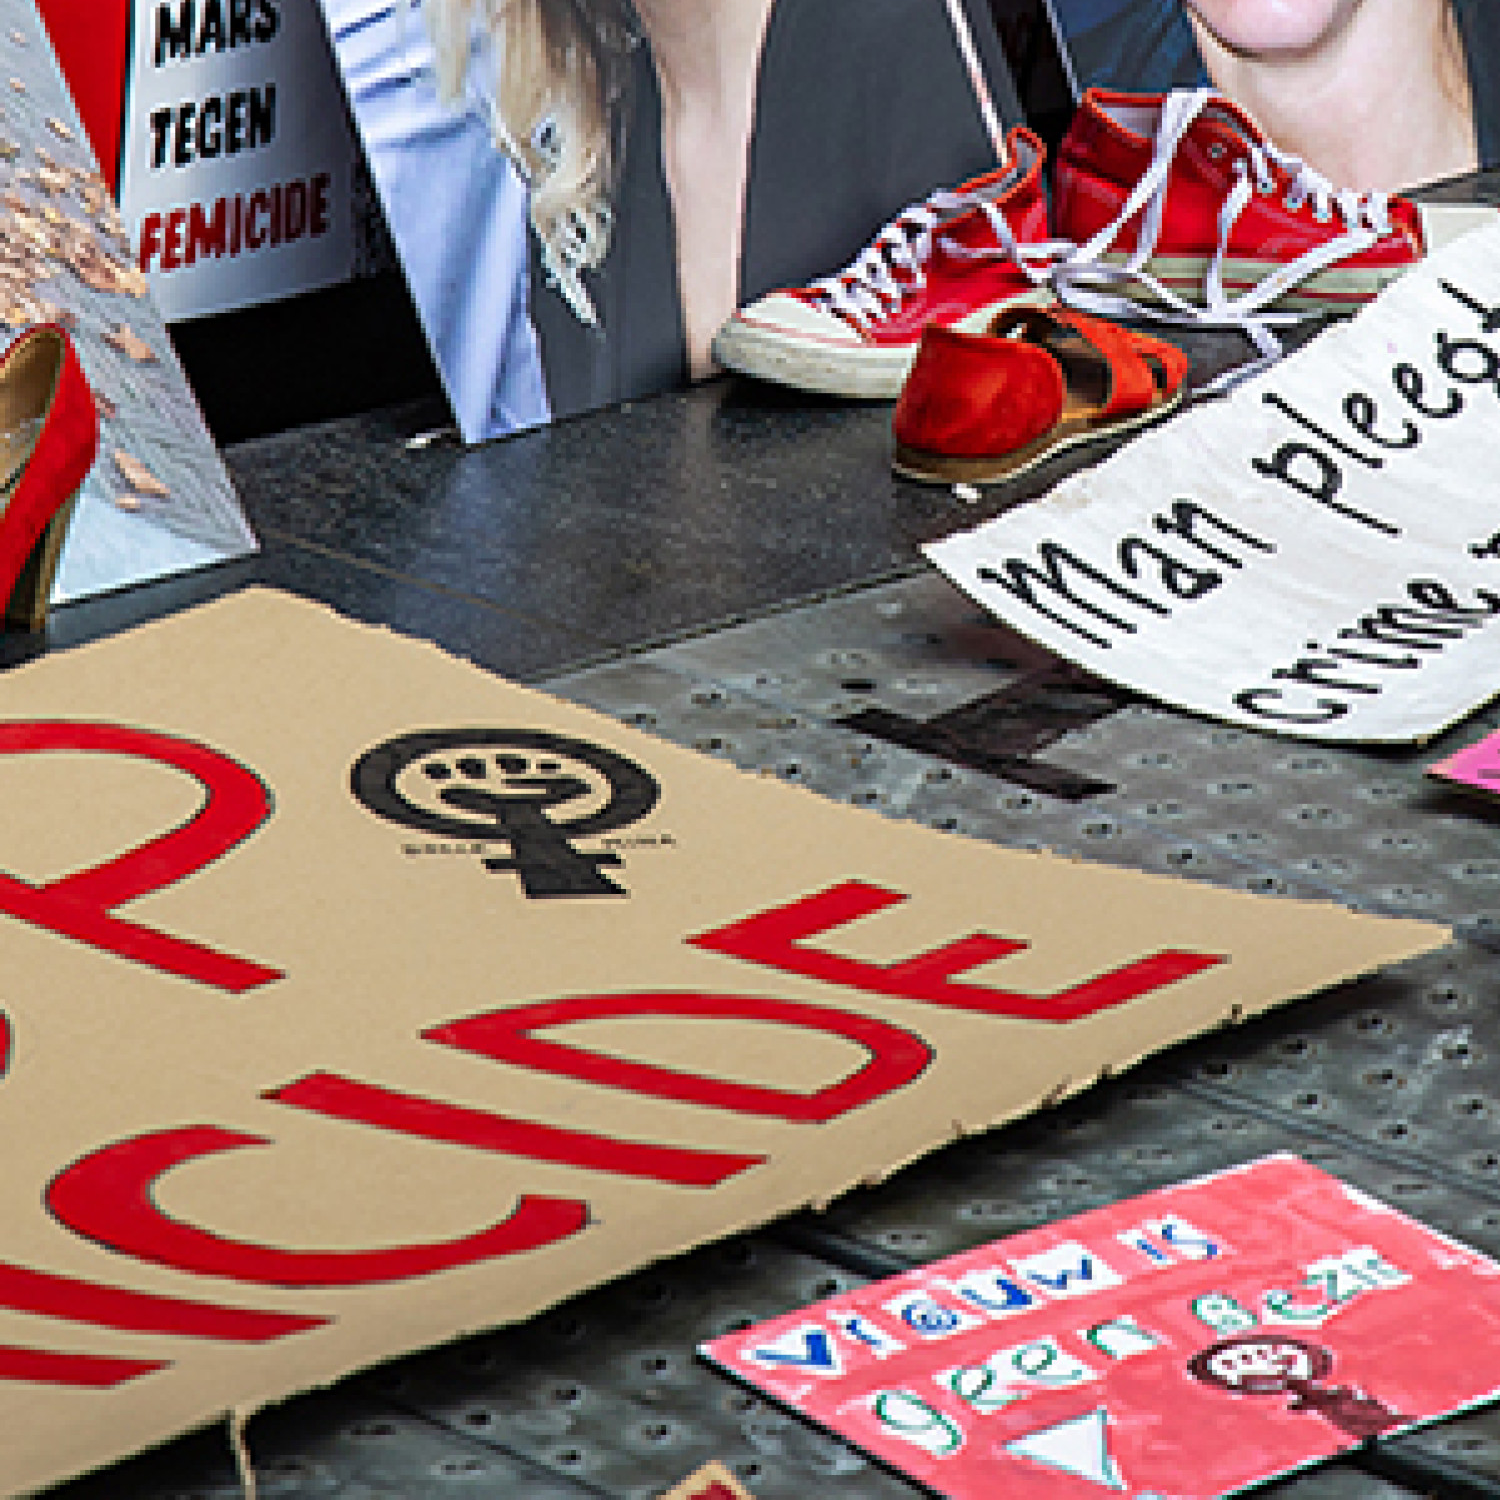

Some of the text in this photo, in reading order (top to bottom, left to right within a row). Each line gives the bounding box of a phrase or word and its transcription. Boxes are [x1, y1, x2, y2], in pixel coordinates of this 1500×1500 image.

[150, 84, 278, 171] TEGEN
[140, 174, 332, 276] FEMICIDE
[978, 498, 1278, 650] Man
